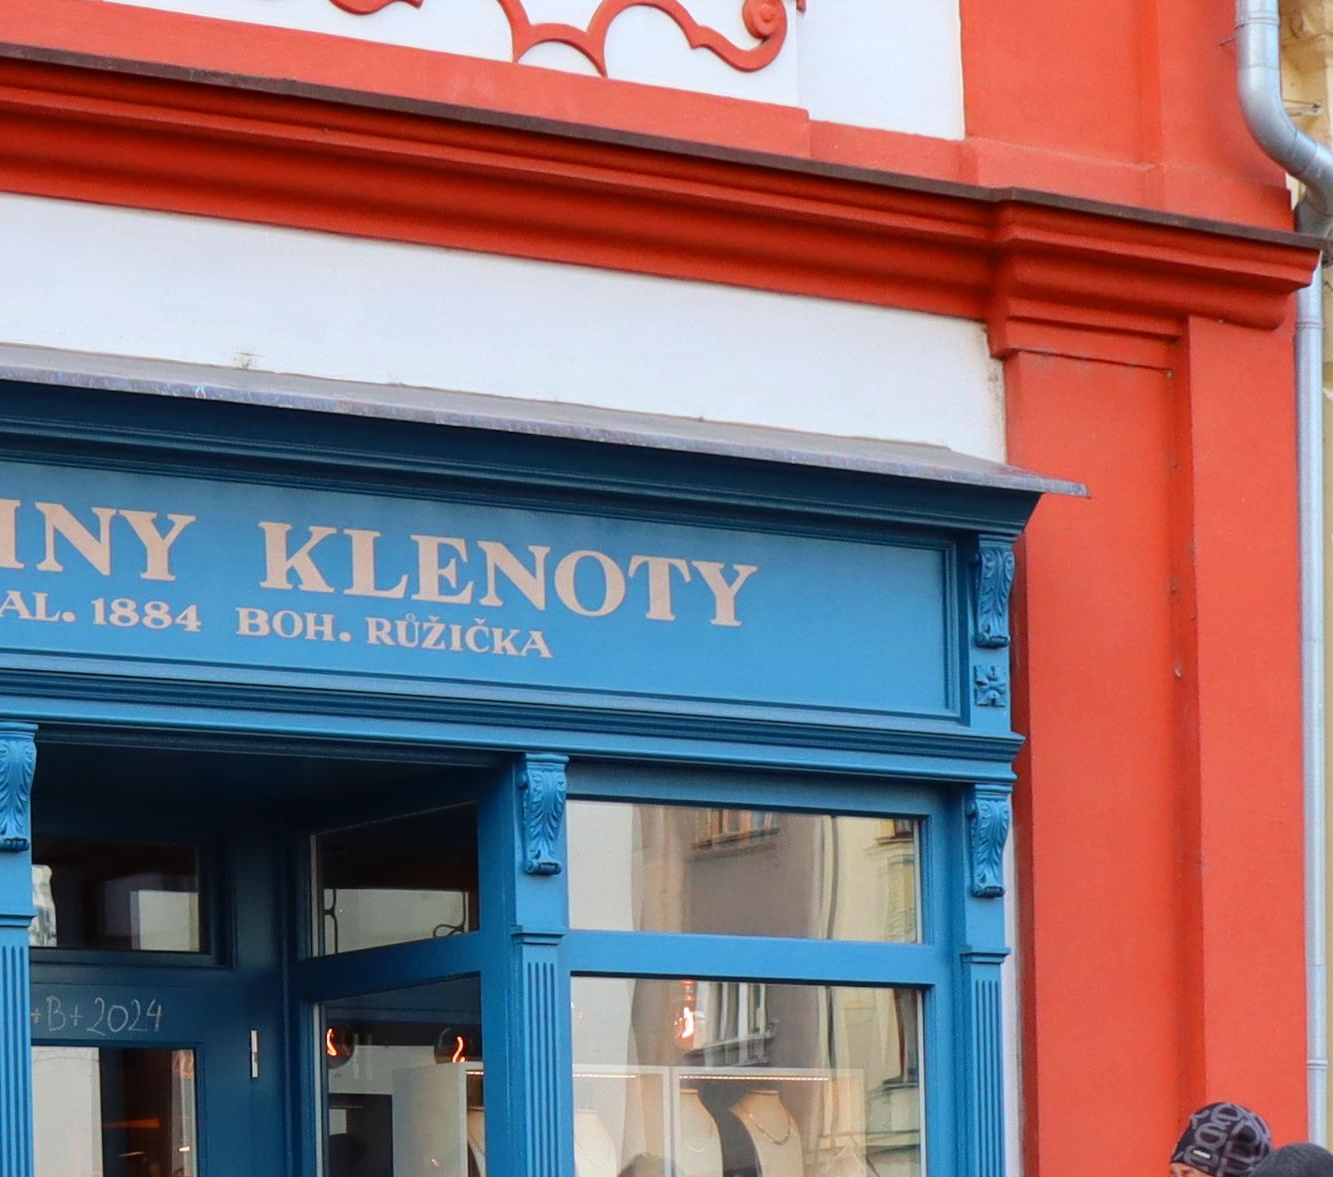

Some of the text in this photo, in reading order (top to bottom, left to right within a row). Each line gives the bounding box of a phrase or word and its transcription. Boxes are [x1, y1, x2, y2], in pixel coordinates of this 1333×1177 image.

[257, 520, 759, 628] KLENOTY
[90, 597, 203, 633] 1884
[235, 606, 353, 643] BOH.
[365, 612, 554, 659] RŮŽIČKA
